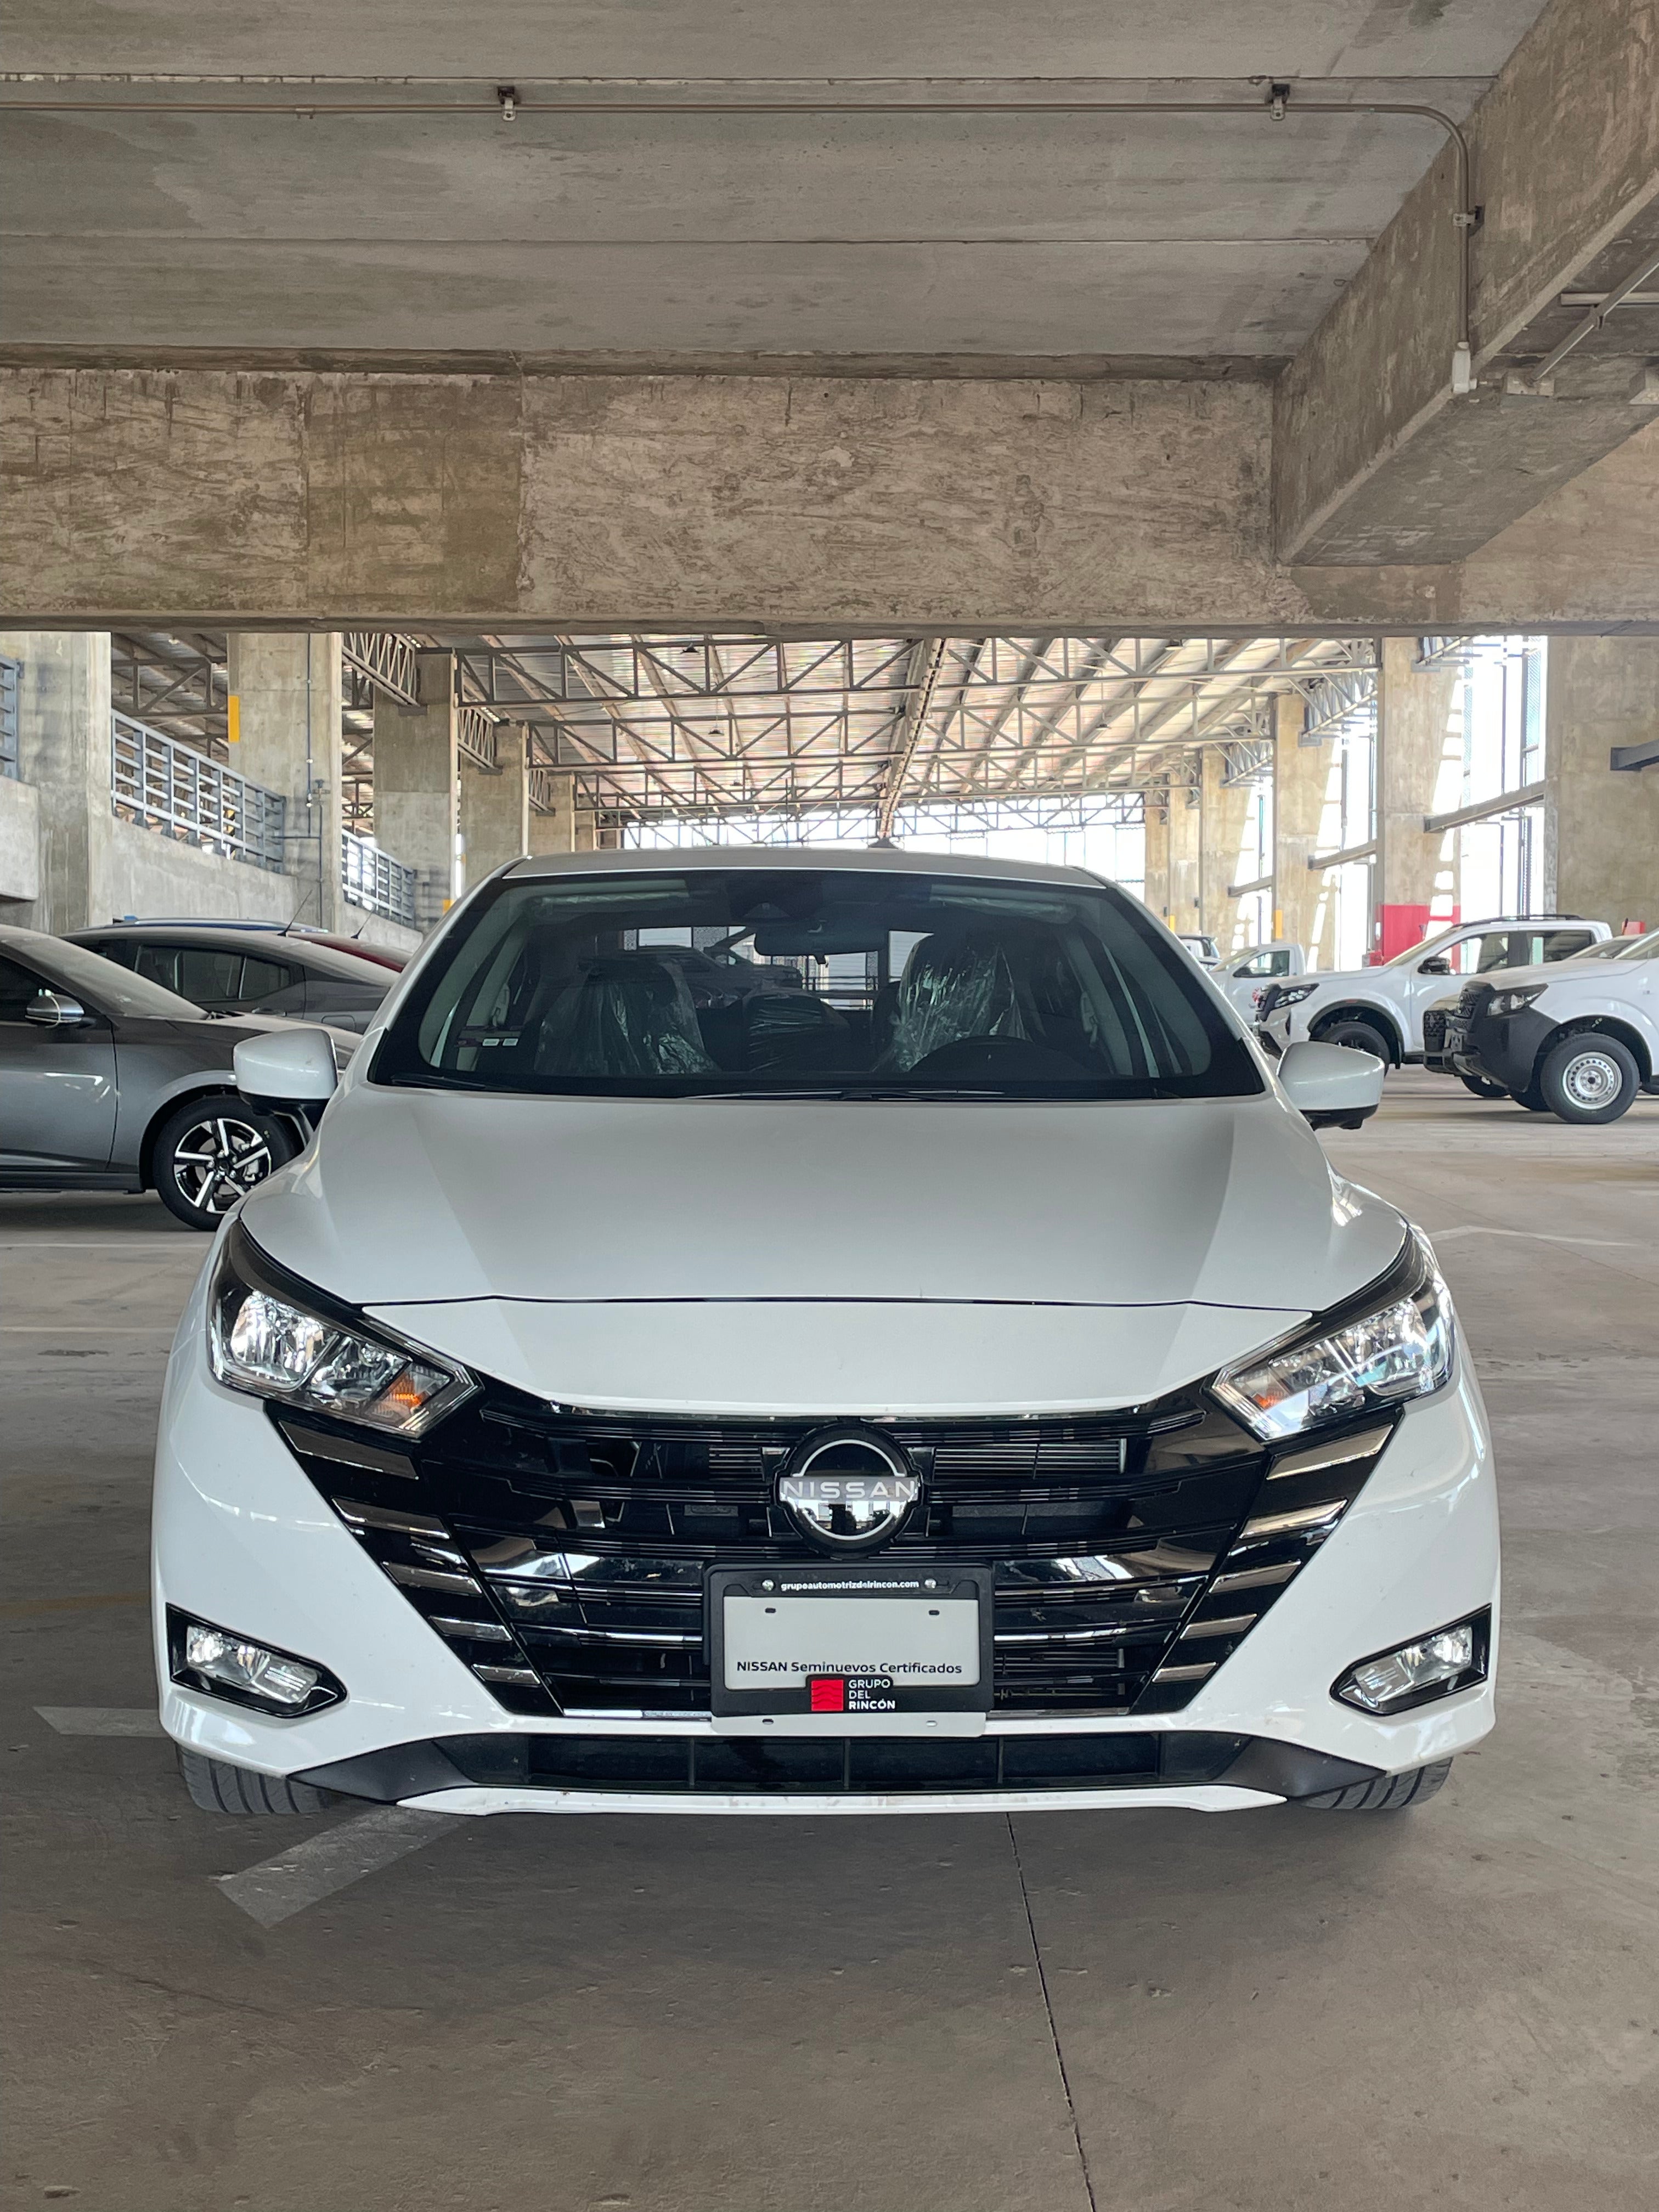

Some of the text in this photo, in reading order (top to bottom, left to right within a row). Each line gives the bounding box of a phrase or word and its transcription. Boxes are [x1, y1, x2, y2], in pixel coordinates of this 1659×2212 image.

[783, 1481, 915, 1498] NISSAN
[781, 1581, 919, 1591] grupoautomotrizdelrincon.com
[736, 1661, 962, 1674] NISSAN Seminuevos Certificados
[848, 1679, 891, 1689] GRUPO
[849, 1690, 871, 1699] DEL
[848, 1699, 896, 1710] RINCÓN
